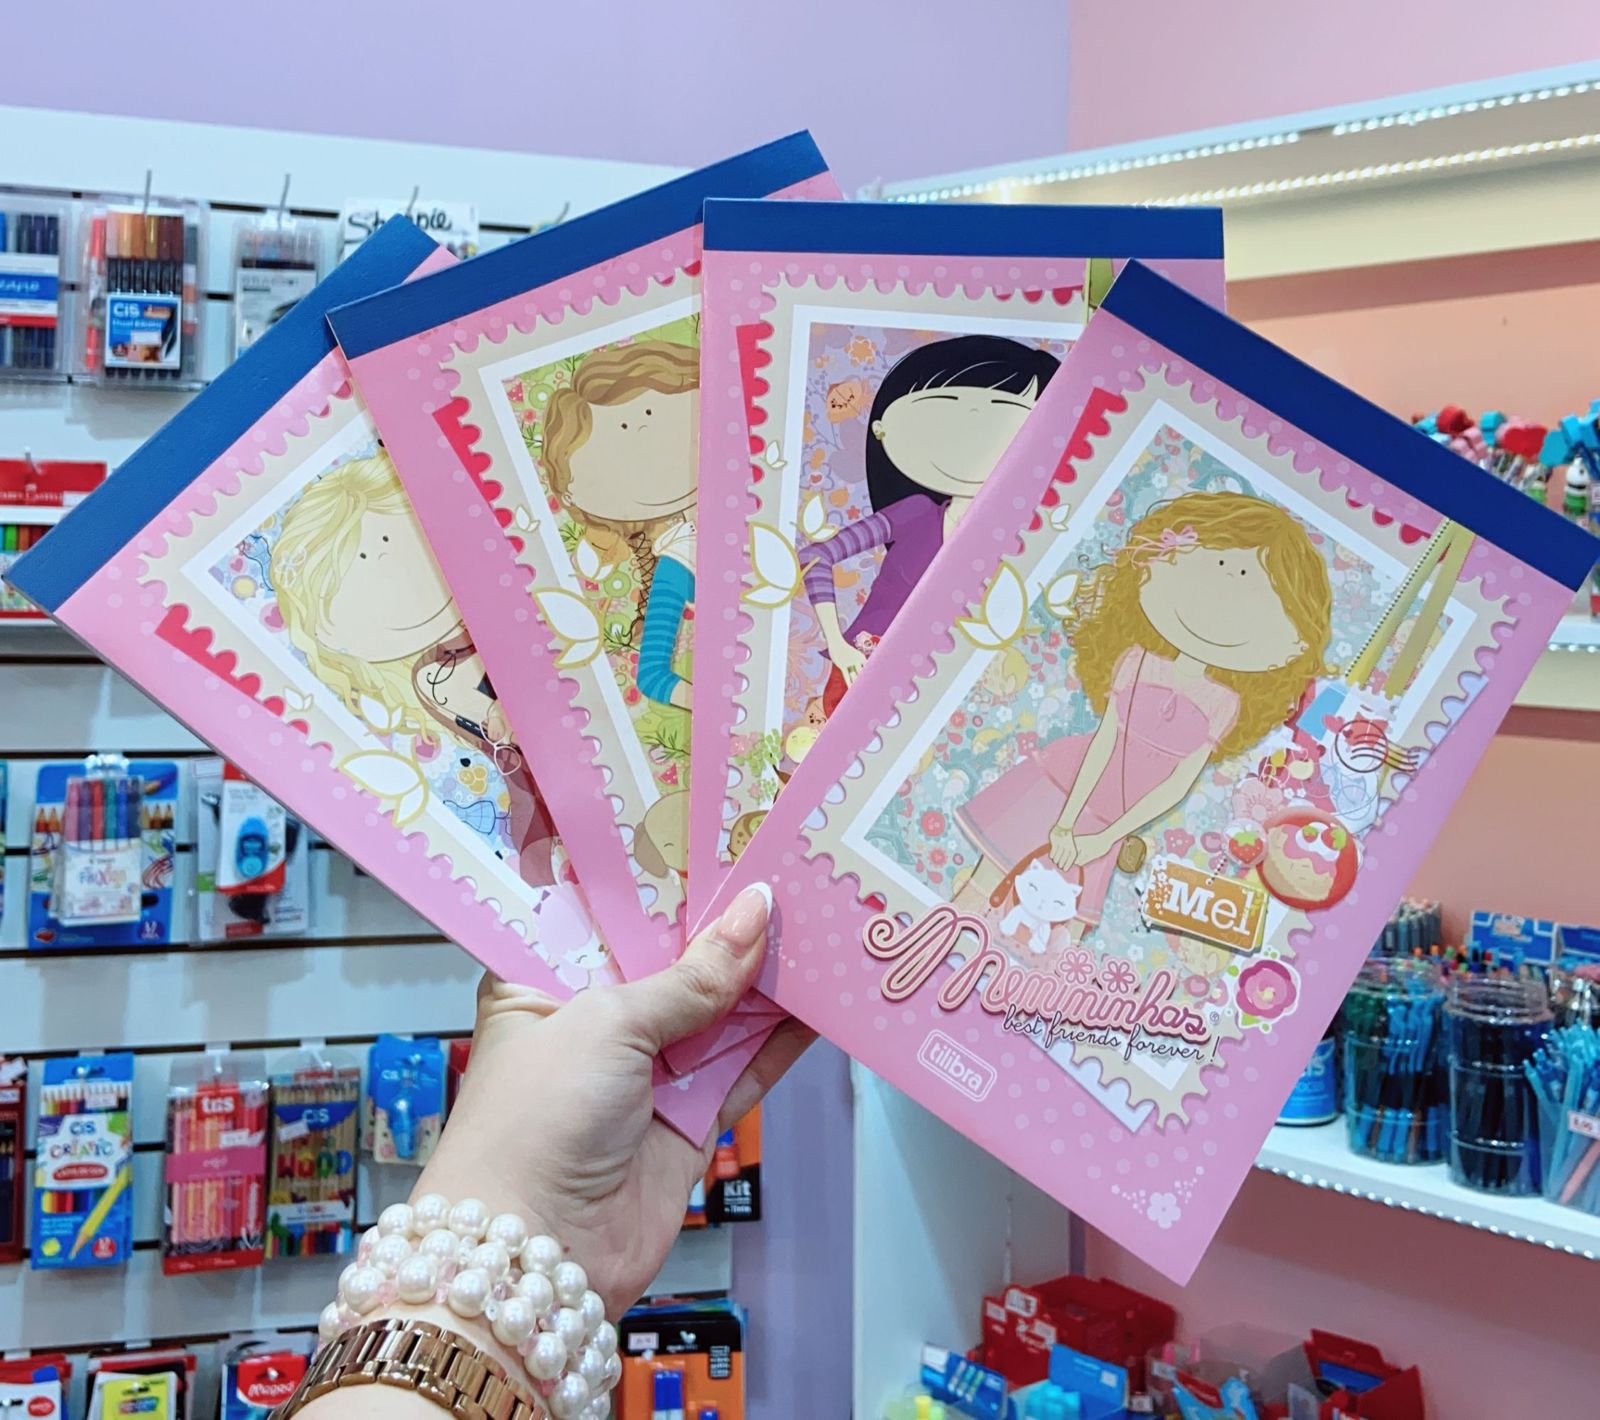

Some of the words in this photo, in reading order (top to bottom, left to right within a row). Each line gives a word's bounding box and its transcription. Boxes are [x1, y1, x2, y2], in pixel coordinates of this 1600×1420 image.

[344, 207, 452, 244] Shpie
[1003, 1003, 1043, 1035] best
[1044, 1010, 1121, 1049] friends
[929, 1042, 983, 1092] tilibra
[723, 1180, 752, 1197] Kit
